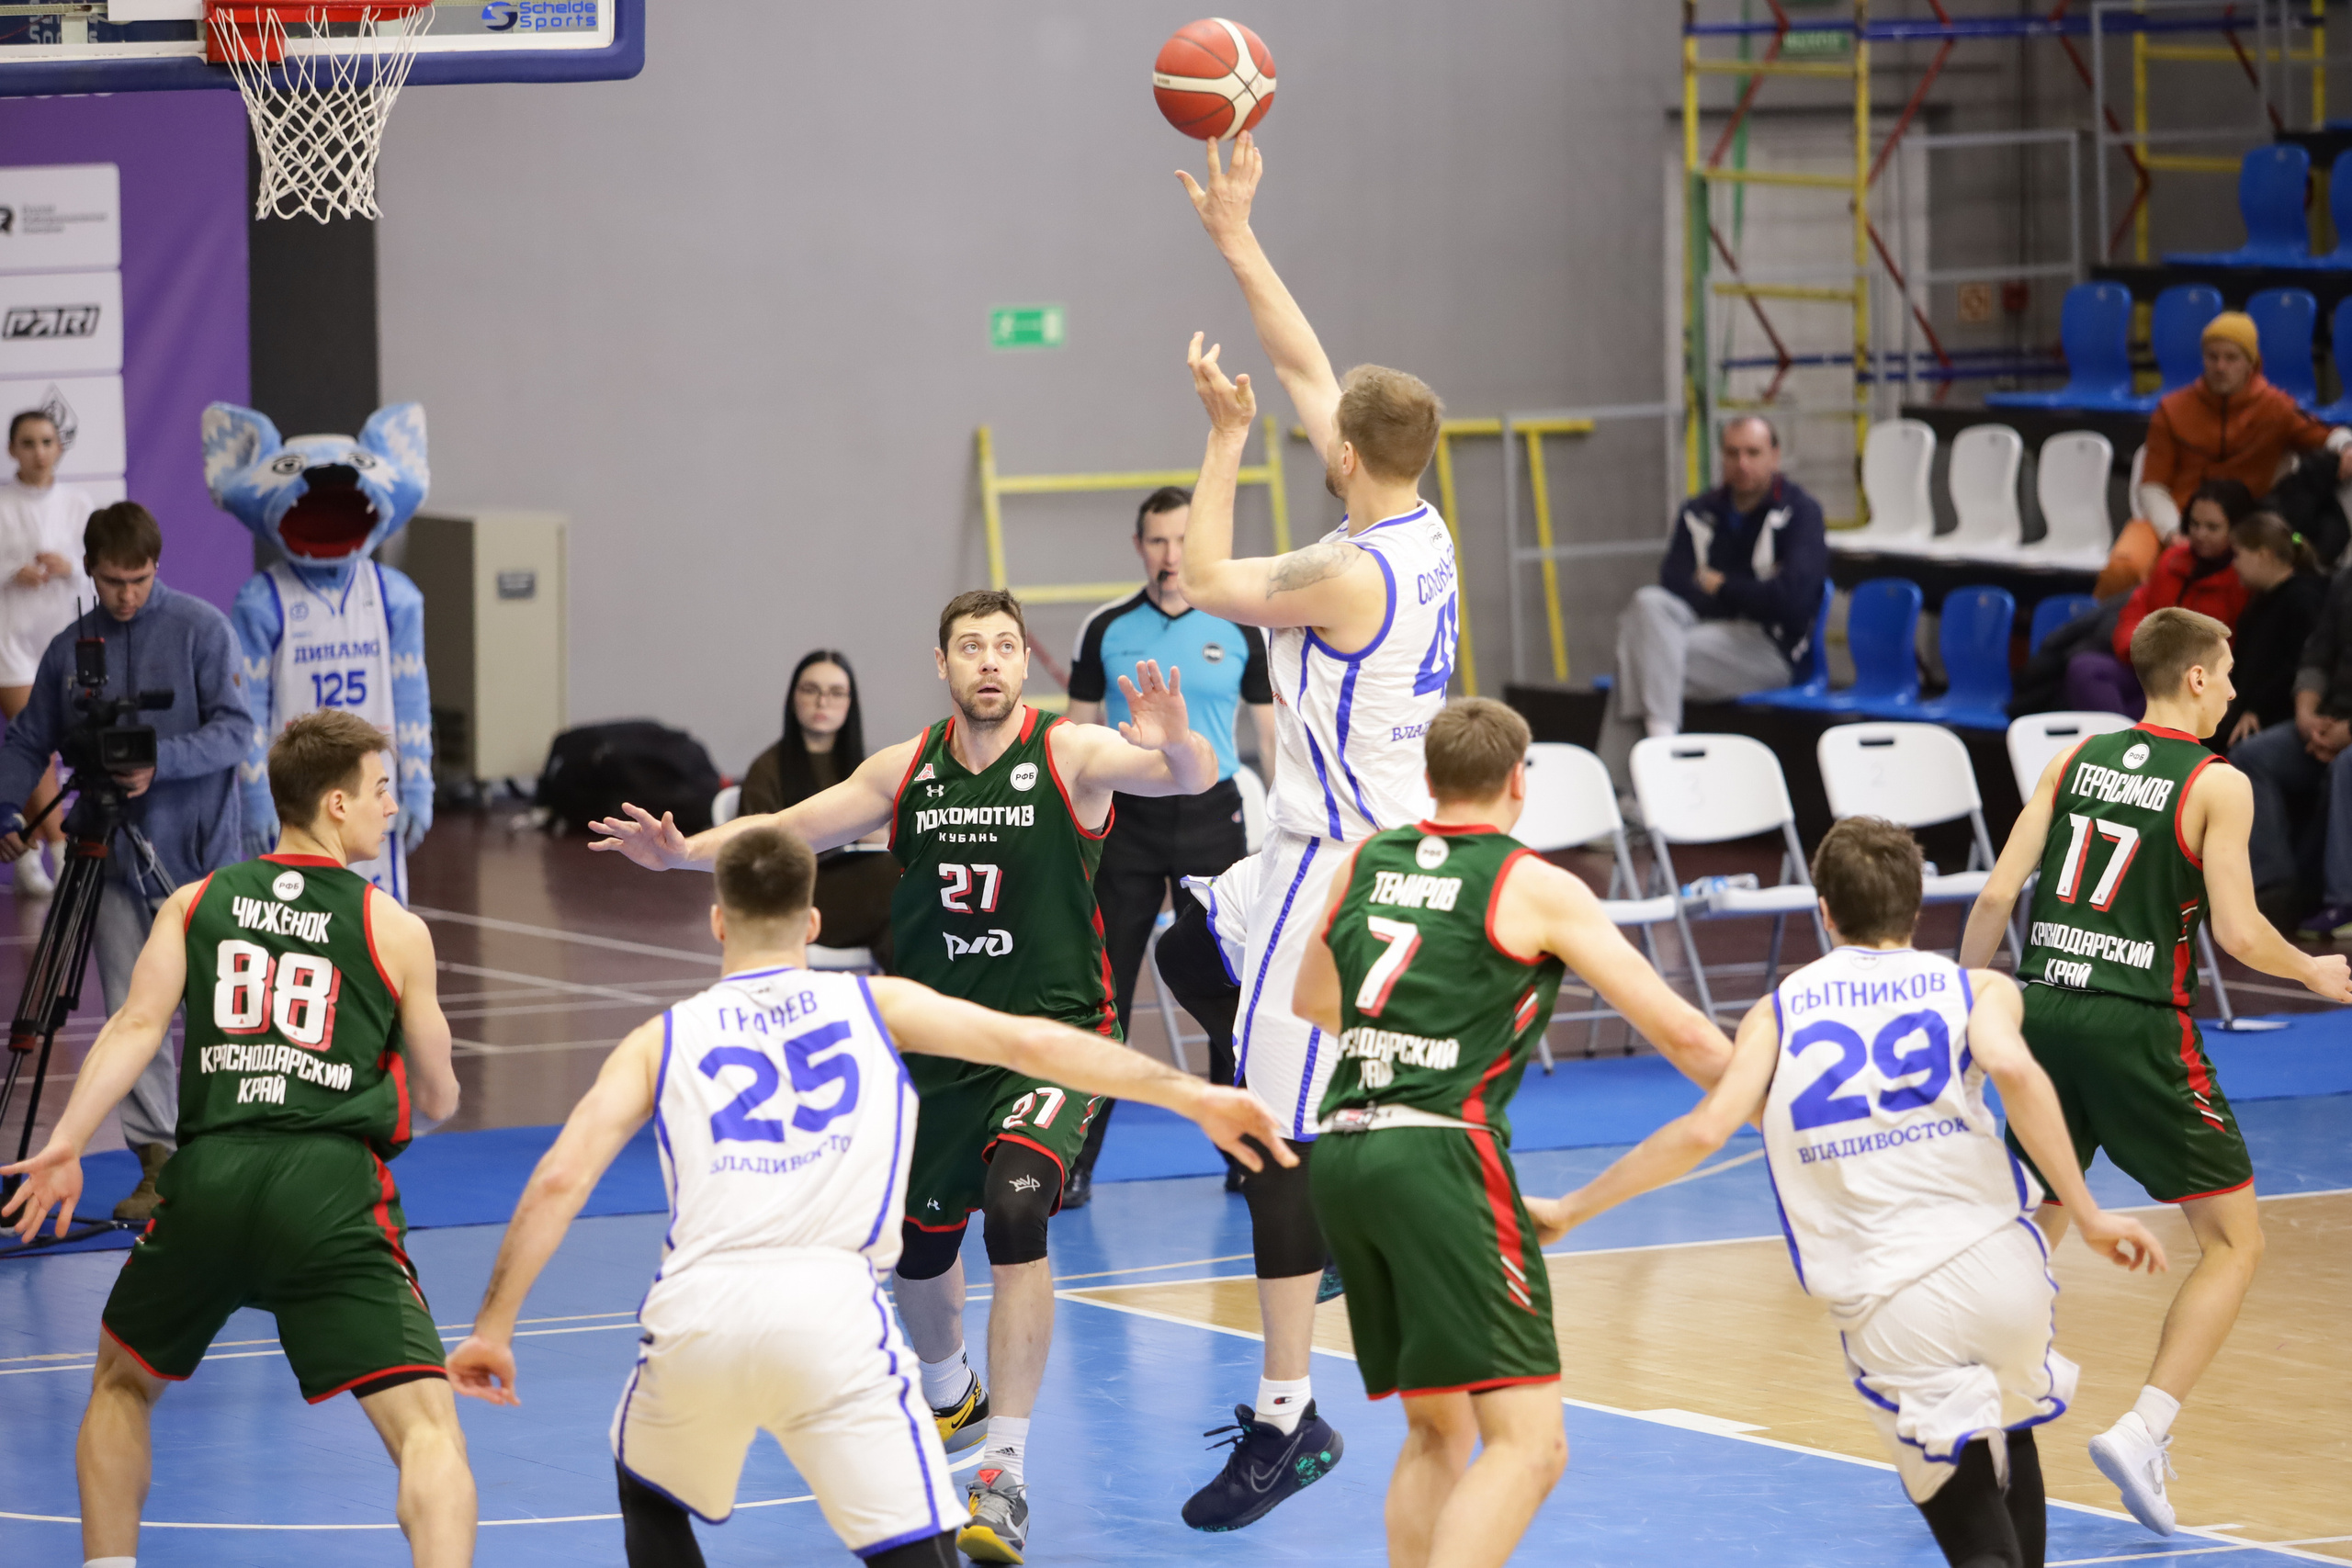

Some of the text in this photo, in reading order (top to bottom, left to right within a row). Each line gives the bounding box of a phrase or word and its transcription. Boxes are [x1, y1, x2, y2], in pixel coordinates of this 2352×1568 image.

[519, 1, 596, 15] Schelde
[519, 16, 596, 31] Sports
[294, 639, 379, 664] ДИНАМО
[311, 671, 367, 707] 125
[1015, 772, 1035, 782] РФБ
[2129, 751, 2145, 761] РФБ
[2071, 762, 2175, 812] ГЕРАСИМОВ
[915, 805, 1035, 834] ЛОКОМОТИВ
[938, 832, 999, 843] КУБАНЬ
[2056, 812, 2141, 912] 17
[278, 881, 300, 890] РФБ
[938, 863, 1003, 914] 27
[1369, 871, 1463, 912] ТЕМИРОВ
[232, 896, 333, 943] ЧИЖЕНОК
[1355, 915, 1422, 1018] 7
[2030, 921, 2155, 970] КРАСНОДАРСКИЙ
[1791, 972, 1947, 1016] СЫТНИКОВ
[2044, 958, 2093, 988] КРАЙ
[213, 939, 342, 1052] 88
[200, 1043, 354, 1091] КРАСНОДАРСКИЙ
[697, 1020, 860, 1145] 25
[1787, 1008, 1951, 1132] 29
[237, 1074, 287, 1105] КРАЙ
[1002, 1087, 1067, 1130] 27
[1797, 1117, 1972, 1165] ВЛАДИВОСТОК
